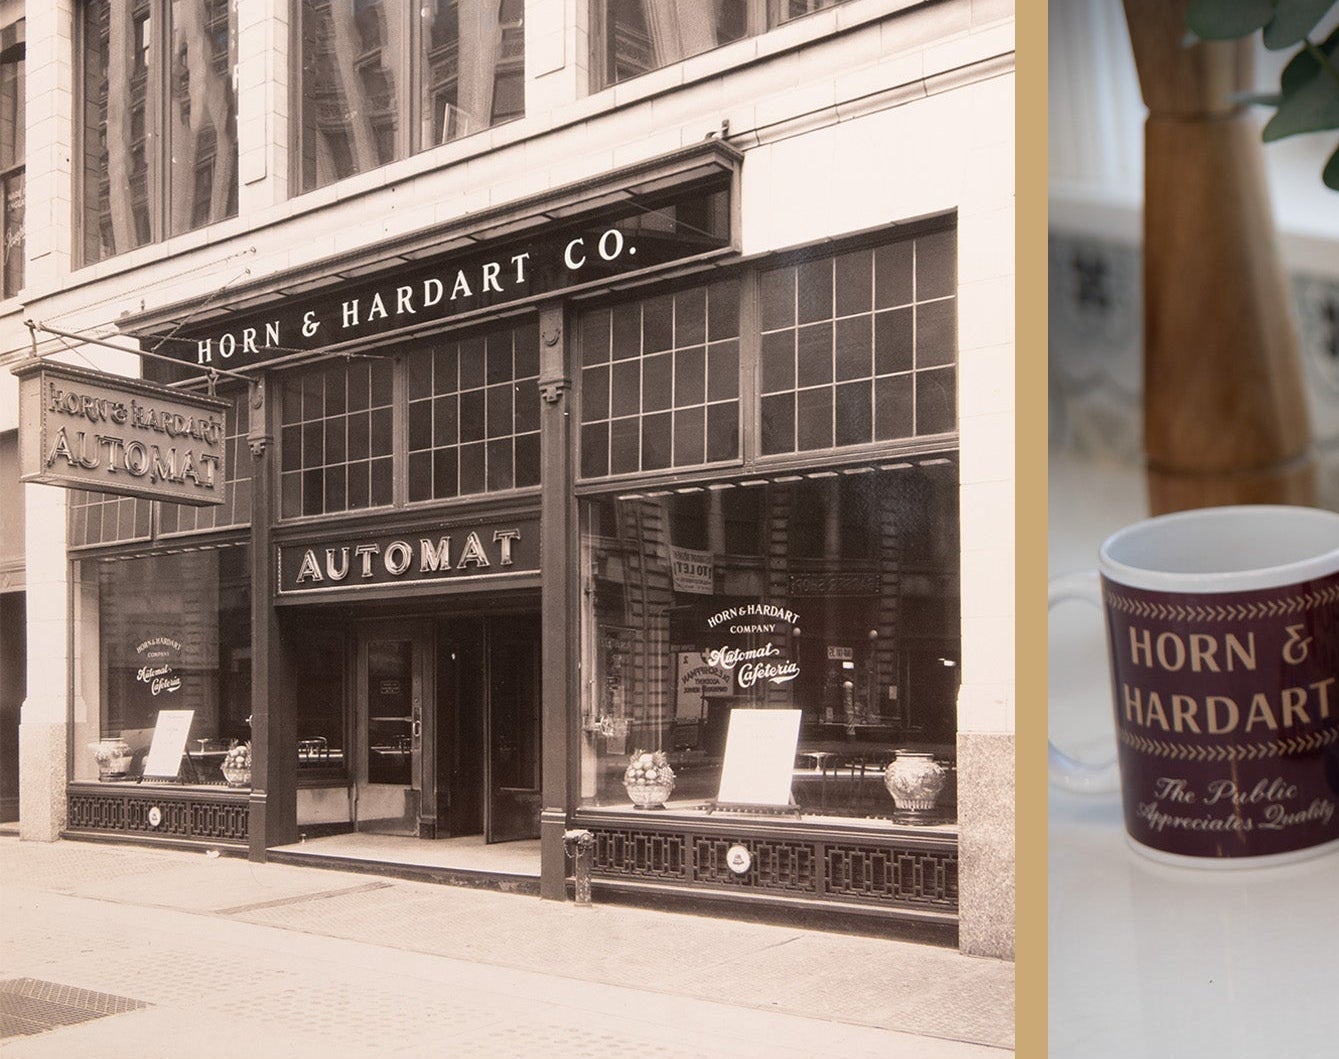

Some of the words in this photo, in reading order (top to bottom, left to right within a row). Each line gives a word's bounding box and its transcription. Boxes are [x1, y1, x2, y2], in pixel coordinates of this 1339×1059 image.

[197, 320, 280, 365] HORN
[302, 311, 320, 337] &
[342, 252, 530, 328] HARDART
[564, 229, 636, 270] CO.
[49, 382, 107, 422] HORN
[110, 402, 128, 424] &
[131, 400, 222, 445] HARDART
[47, 426, 219, 488] AUTOMAT
[296, 528, 521, 583] AUTOMAT
[707, 607, 738, 628] HORN
[738, 606, 746, 616] &
[747, 604, 800, 624] HARDART
[730, 624, 776, 634] COMPANY
[708, 642, 780, 669] Automat
[1129, 626, 1257, 672] HORN
[1282, 624, 1313, 665] &
[738, 660, 800, 689] Cafeteria
[1123, 677, 1335, 734] HARDART
[1154, 777, 1196, 804] The
[1204, 777, 1298, 805] Public
[1136, 802, 1253, 832] Appreciates
[1259, 799, 1335, 830] Quality
